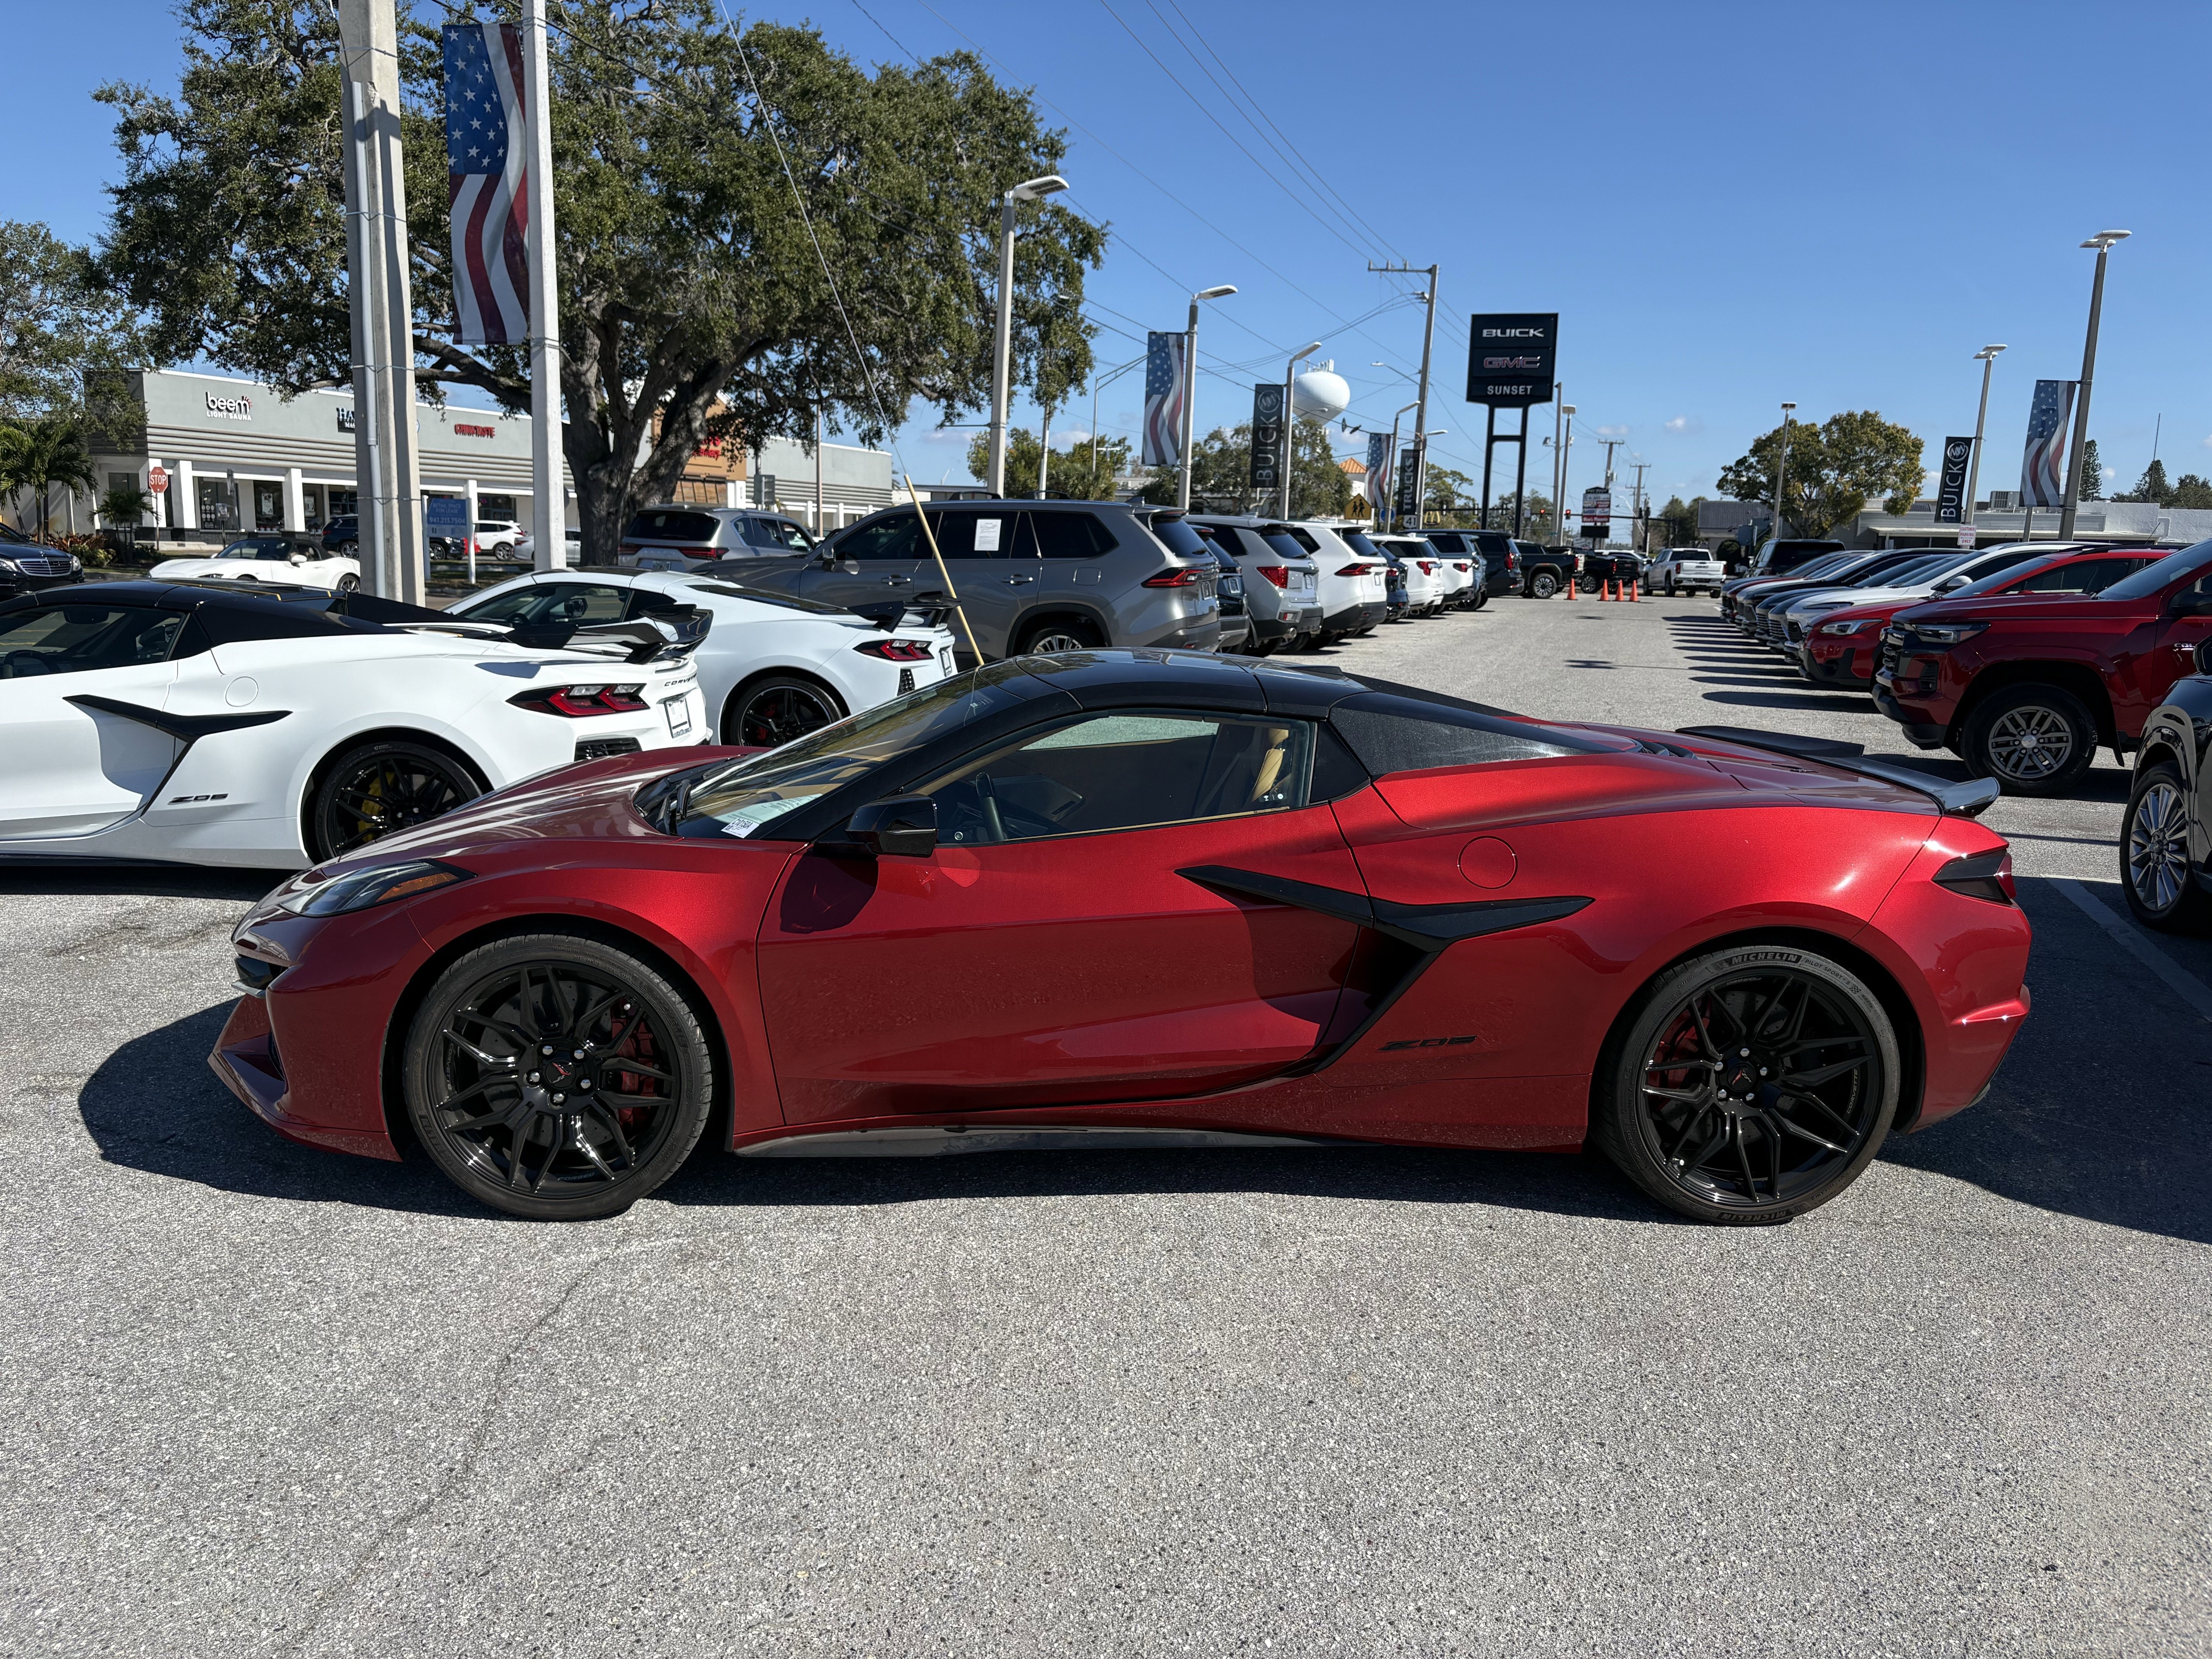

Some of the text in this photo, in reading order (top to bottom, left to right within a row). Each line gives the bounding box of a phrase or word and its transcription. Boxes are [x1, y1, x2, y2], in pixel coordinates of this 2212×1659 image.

[1482, 328, 1544, 337] BUICK
[1484, 356, 1540, 368] GMC
[1487, 385, 1533, 395] SUNSET
[207, 391, 250, 414] beem
[207, 410, 252, 421] LIGHT SAUNA
[1256, 416, 1277, 480] BUICK
[150, 474, 167, 485] STOP
[1403, 458, 1413, 511] TRUCKS
[1941, 463, 1964, 518] BUICK
[1406, 517, 1416, 526] 41
[168, 793, 228, 804] Z06
[1731, 952, 1798, 964] MICHELIN
[1805, 959, 1823, 968] PILOT
[1823, 967, 1843, 979] SPORT
[1377, 1035, 1477, 1052] Z06
[1847, 1068, 1858, 1114] CORVETTE
[558, 1172, 594, 1180] FORGED
[1722, 1211, 1786, 1221] MICHELIN
